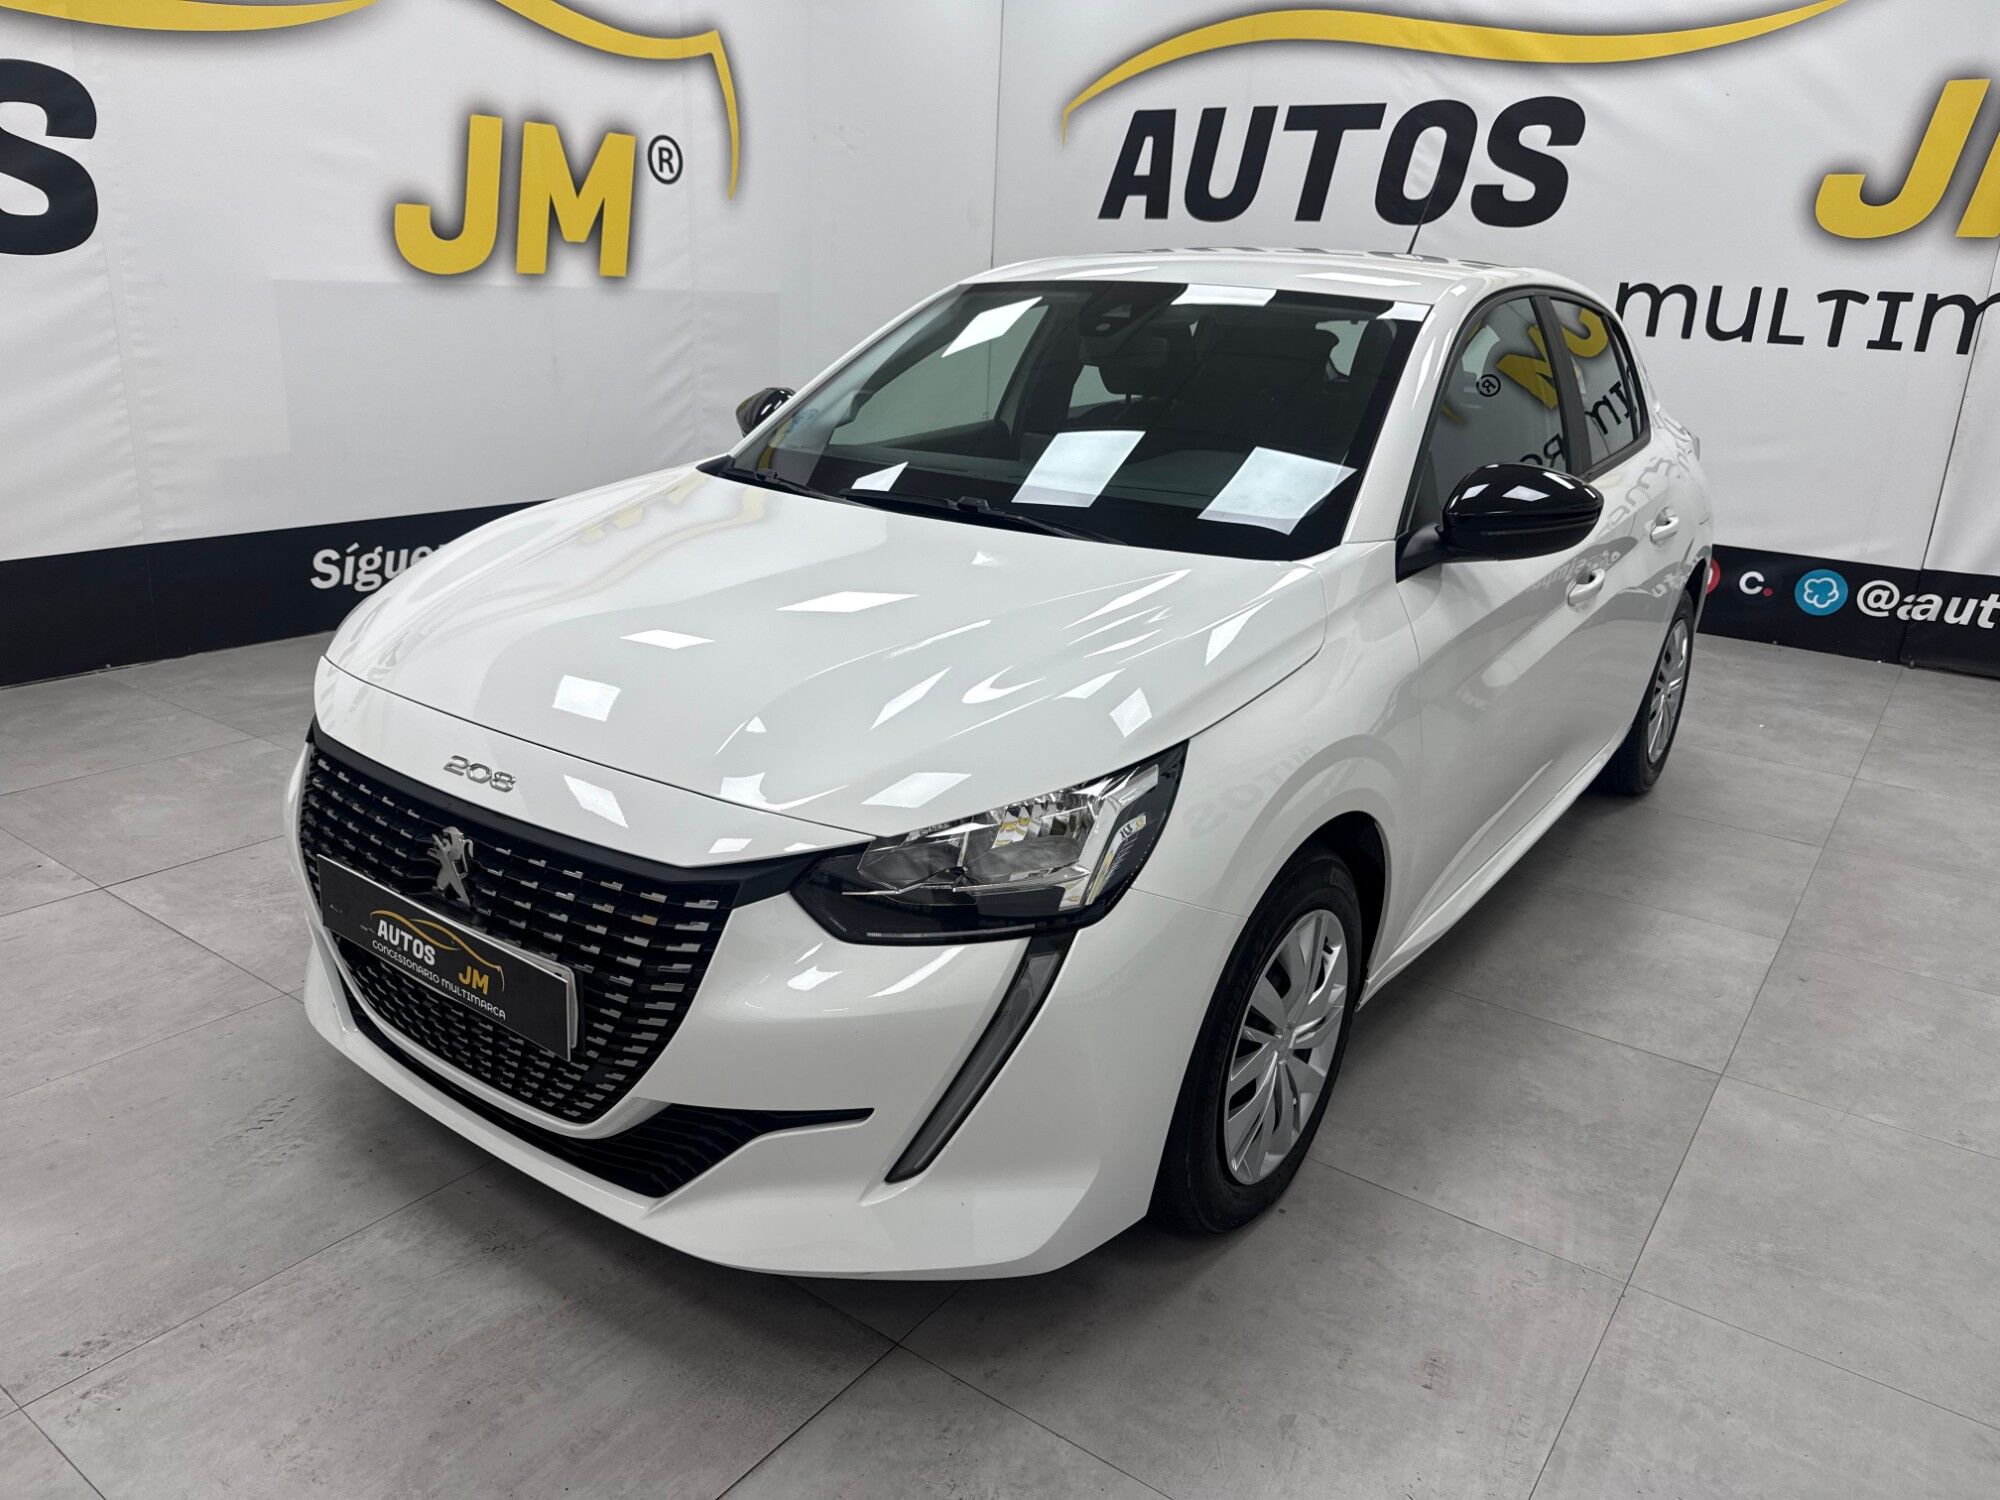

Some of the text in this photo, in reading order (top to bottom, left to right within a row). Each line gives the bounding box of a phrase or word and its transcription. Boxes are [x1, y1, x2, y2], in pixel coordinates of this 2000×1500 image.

[394, 114, 636, 277] JM
[1097, 79, 2000, 239] AUTOS J
[310, 542, 446, 592] Sígue
[443, 755, 516, 793] 208
[377, 919, 489, 995] AUTOS JM
